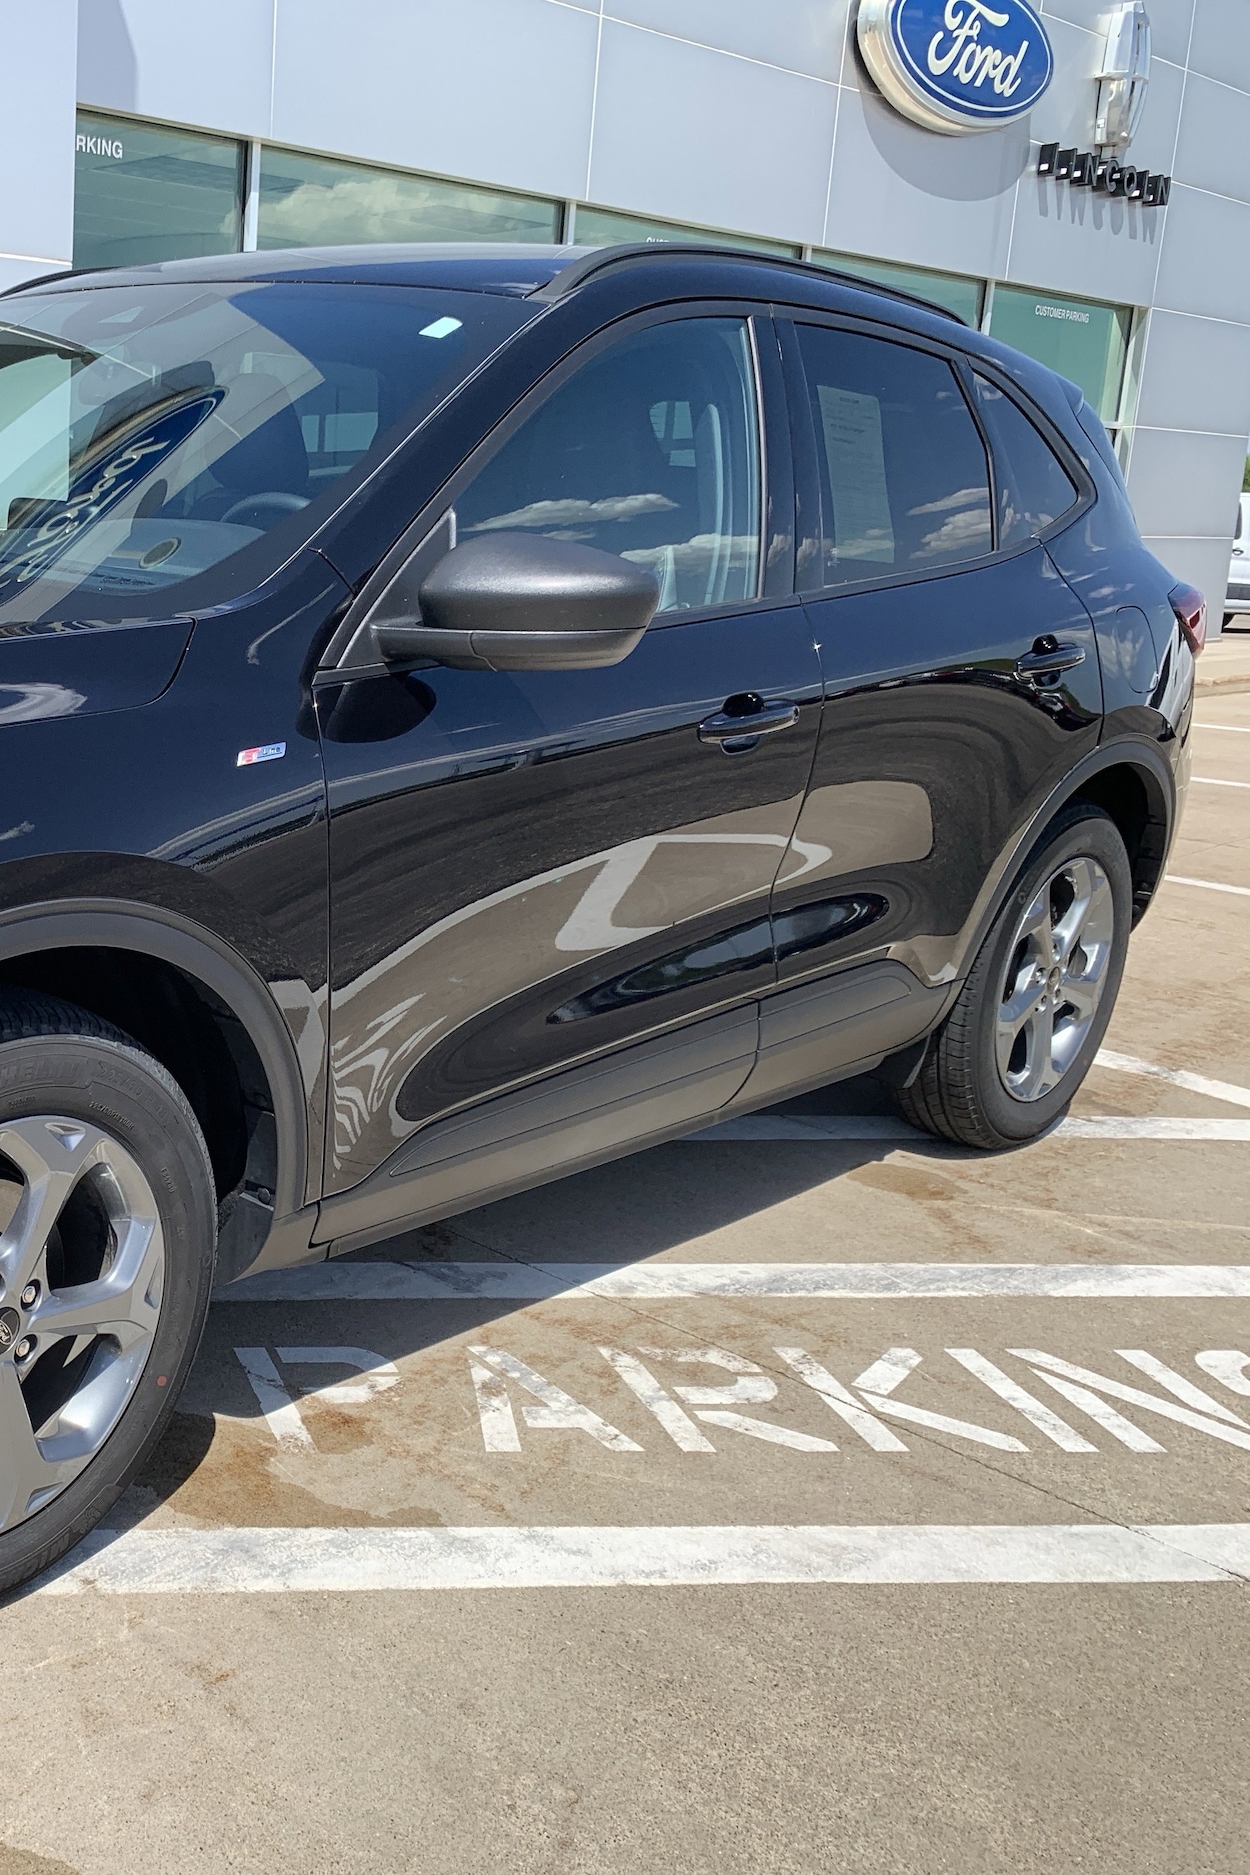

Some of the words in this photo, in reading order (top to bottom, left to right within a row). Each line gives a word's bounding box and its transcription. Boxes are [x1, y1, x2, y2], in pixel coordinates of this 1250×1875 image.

[927, 0, 1030, 98] Ford
[1037, 142, 1172, 206] LINCOLN
[1035, 304, 1066, 319] CUSTOMER
[1065, 309, 1090, 323] PARKING
